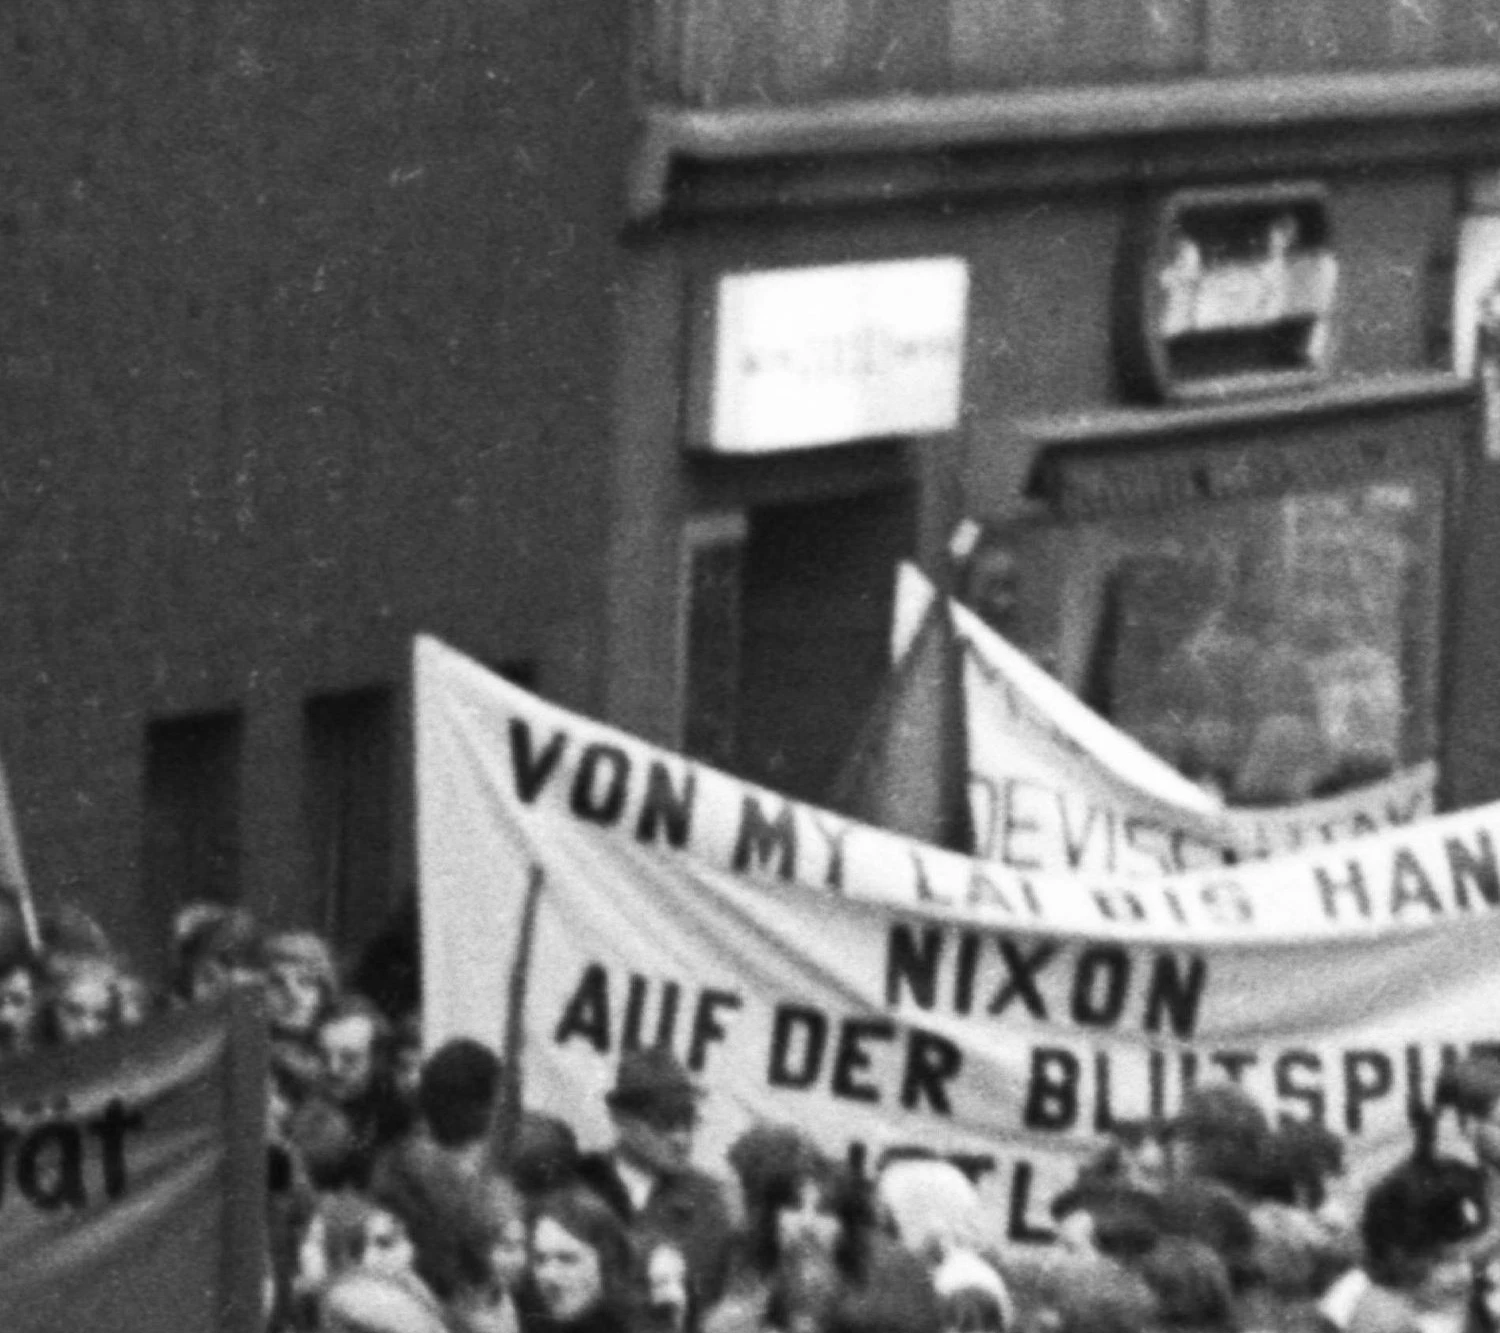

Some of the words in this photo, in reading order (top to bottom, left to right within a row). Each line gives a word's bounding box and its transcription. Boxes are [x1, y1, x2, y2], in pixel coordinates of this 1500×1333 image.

[508, 714, 698, 851] VON
[732, 796, 852, 890] MY
[553, 961, 745, 1074] AUF
[766, 1002, 963, 1117] DER
[886, 921, 1206, 1042] NIXON
